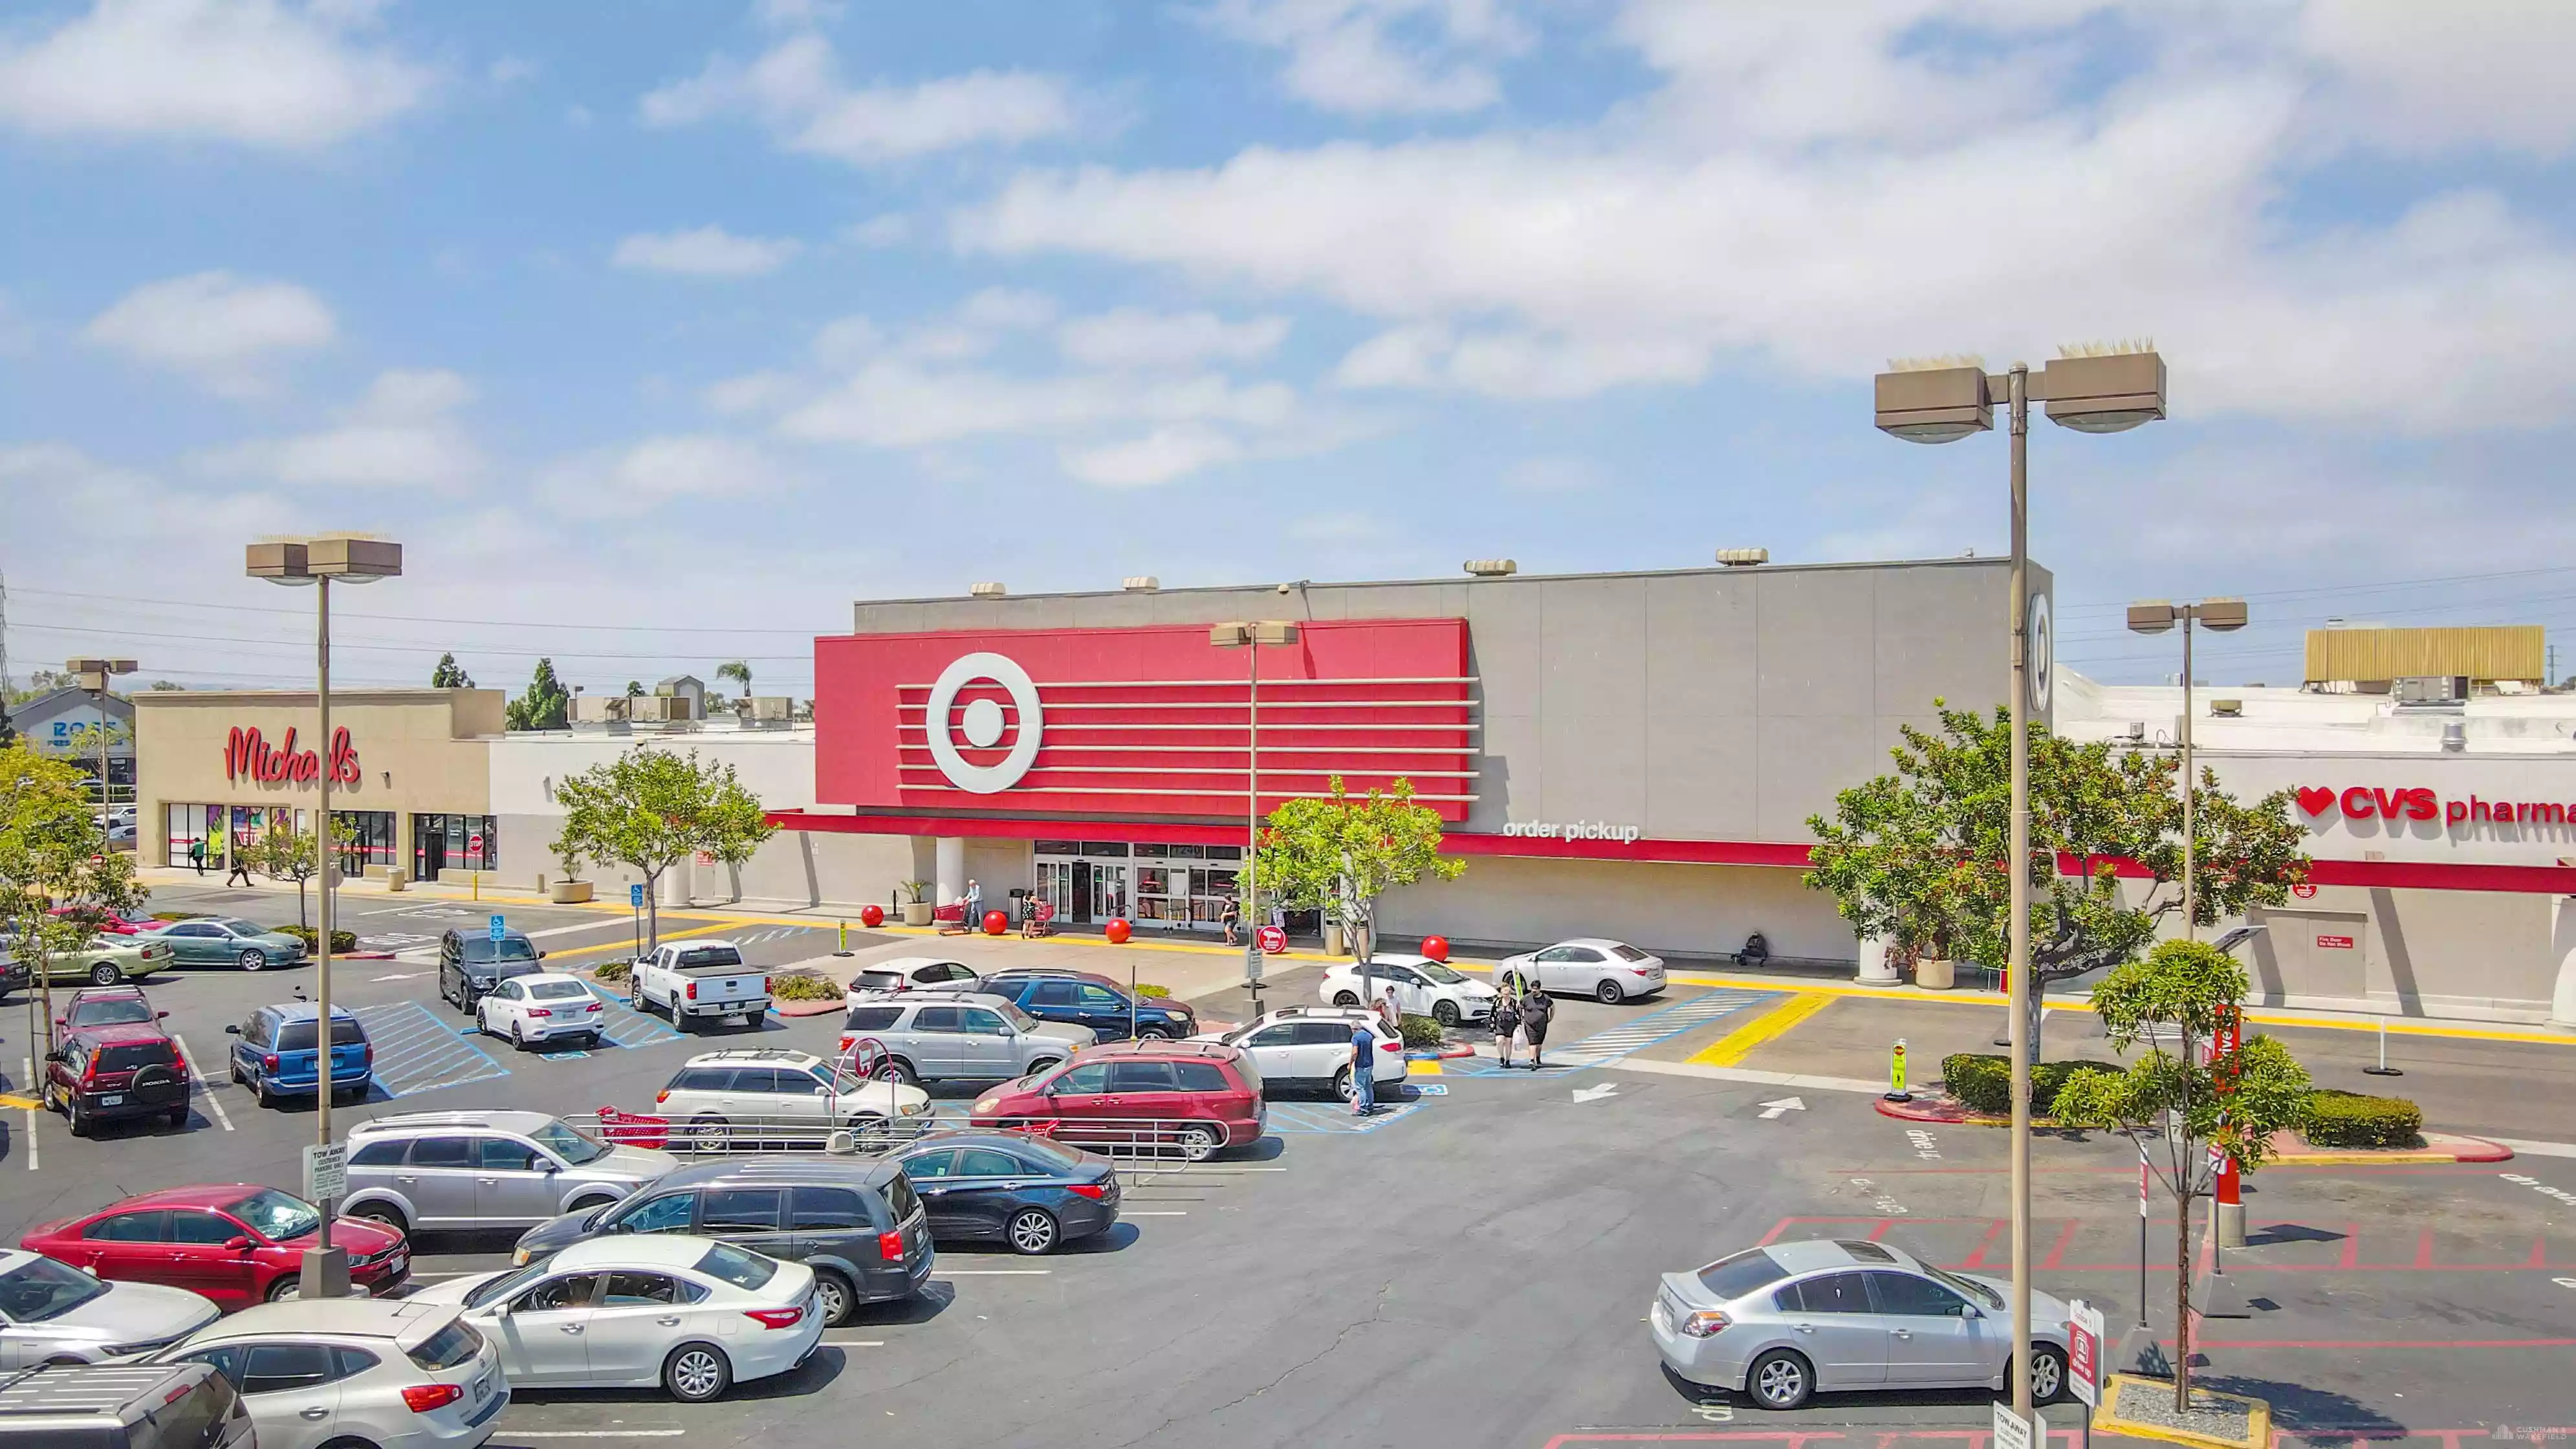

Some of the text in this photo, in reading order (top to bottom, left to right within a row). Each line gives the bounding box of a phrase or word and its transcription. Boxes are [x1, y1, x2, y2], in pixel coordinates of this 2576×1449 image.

[224, 725, 361, 783] Michals
[2340, 787, 2438, 820] CVS
[1503, 819, 1638, 844] order pickup
[1905, 1129, 1937, 1149] drive
